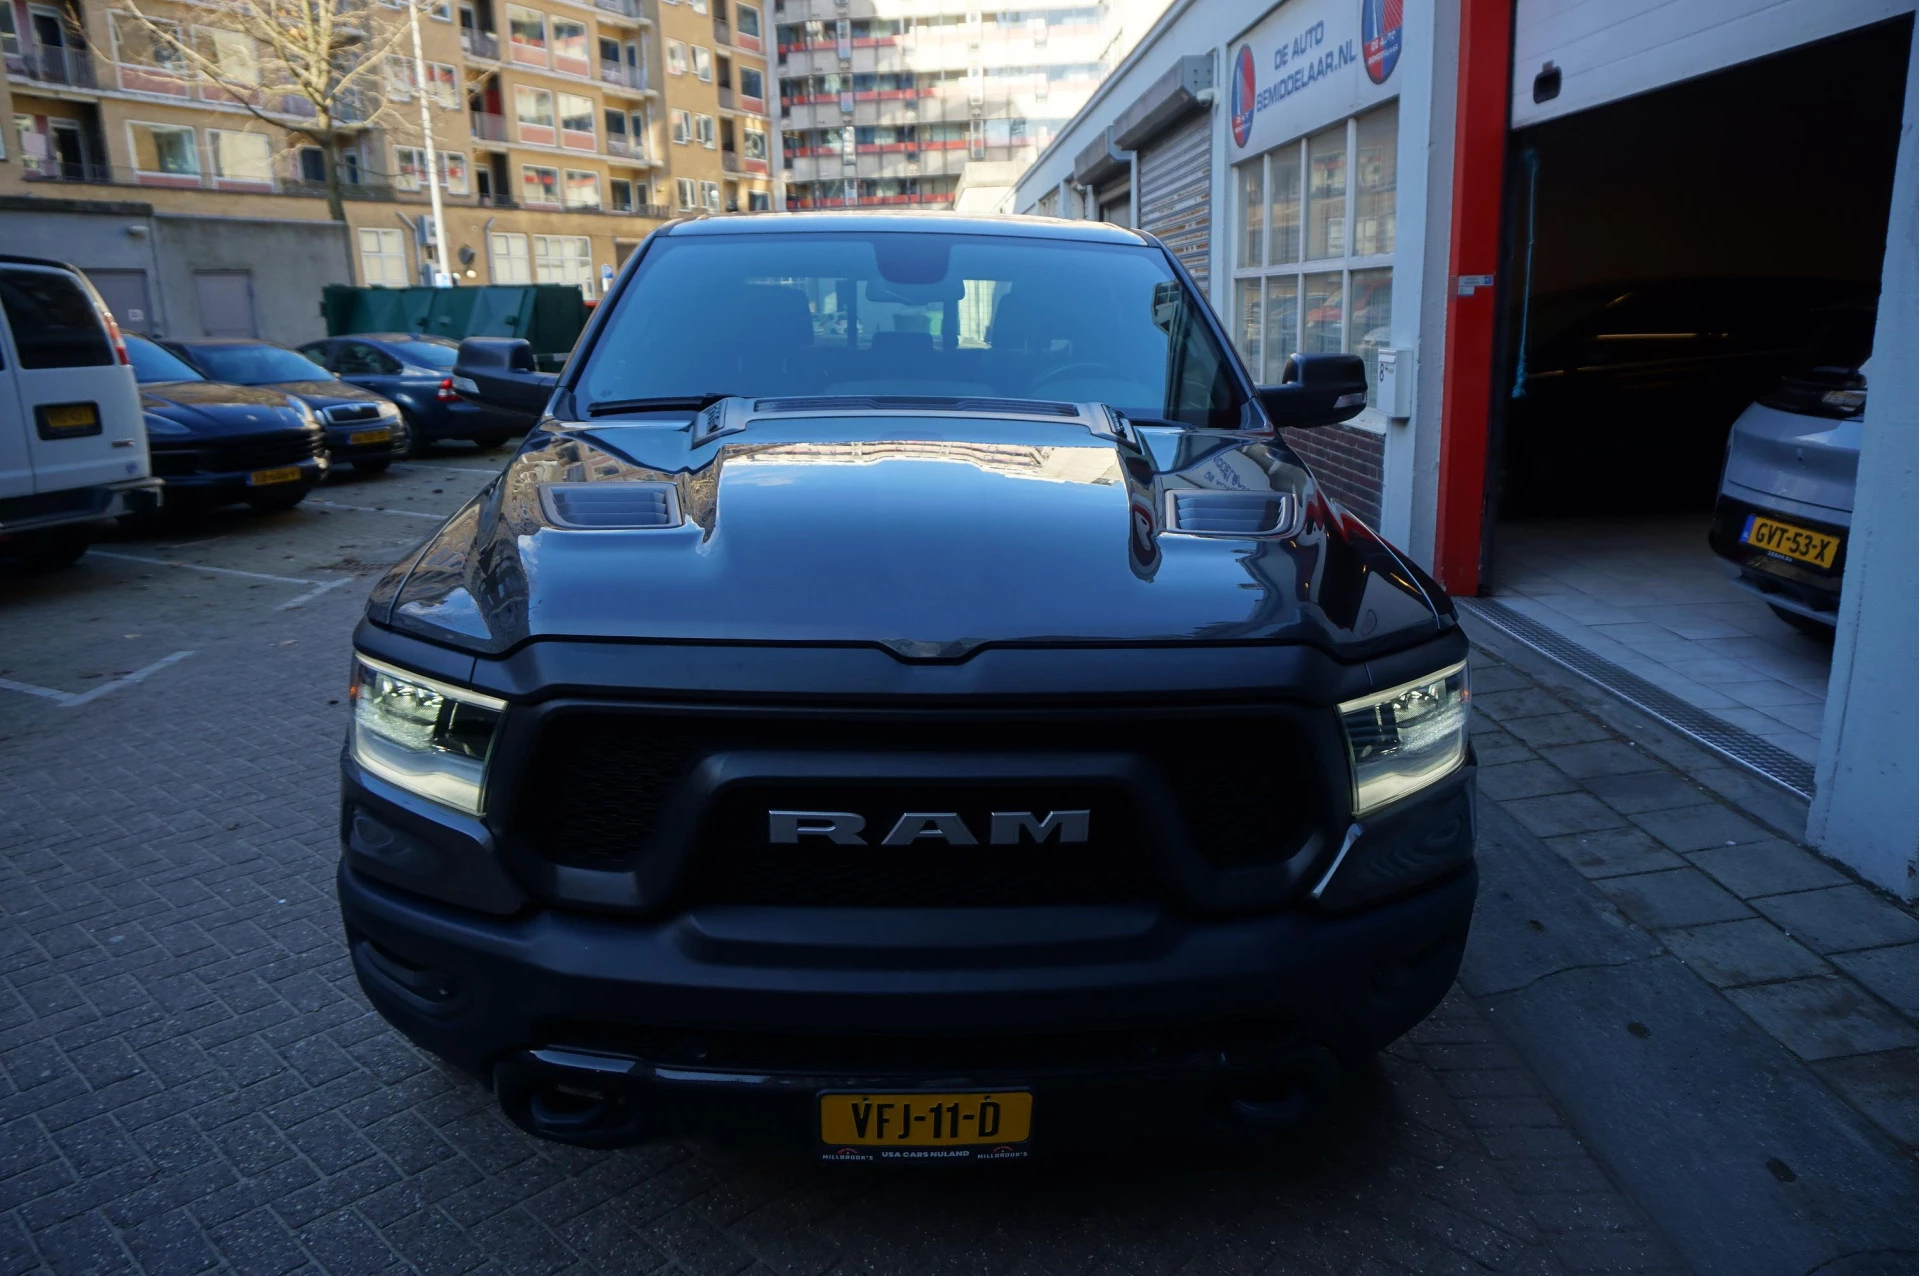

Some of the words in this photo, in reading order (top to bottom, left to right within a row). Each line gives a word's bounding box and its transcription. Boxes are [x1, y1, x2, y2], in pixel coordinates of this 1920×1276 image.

[1274, 43, 1289, 71] DE
[1291, 20, 1324, 60] AUTO
[1256, 39, 1356, 112] BEMIDDELAAR.NL
[1379, 363, 1385, 382] 8
[1755, 521, 1832, 563] GVT-53-X
[768, 809, 1091, 845] RAM
[851, 1101, 1001, 1139] VFJ-11-D
[930, 1150, 970, 1158] NULAND
